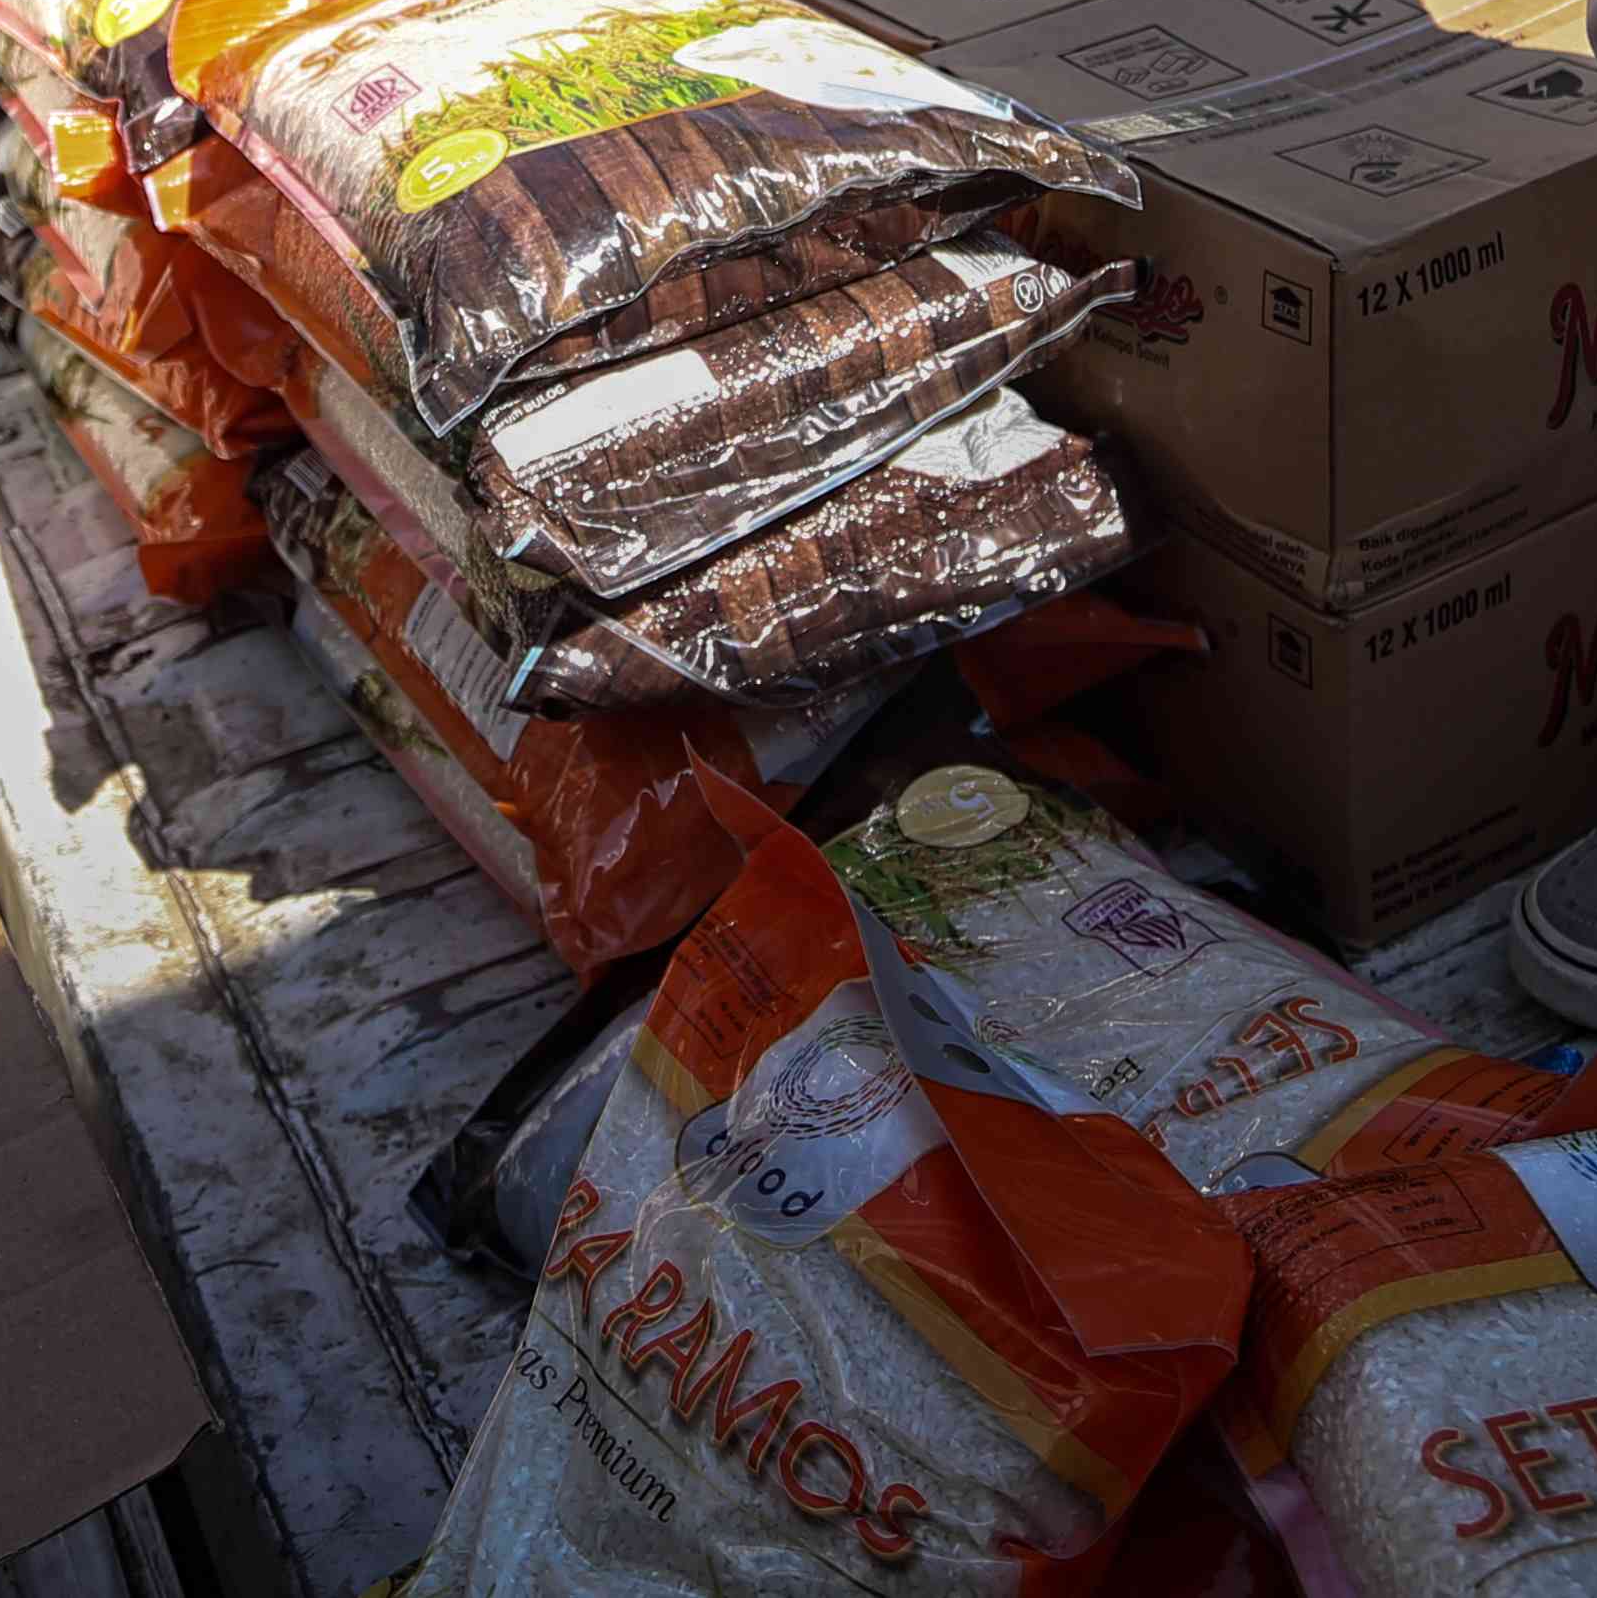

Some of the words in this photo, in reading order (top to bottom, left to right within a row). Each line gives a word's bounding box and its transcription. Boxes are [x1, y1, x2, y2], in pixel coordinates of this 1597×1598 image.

[418, 154, 456, 194] 5
[1357, 282, 1388, 317] 12
[1395, 270, 1413, 307] X
[1415, 246, 1472, 295] 1000
[1477, 230, 1506, 271] ml
[522, 382, 567, 415] BULOG
[1364, 628, 1394, 663] 12
[1402, 616, 1417, 649] X
[1425, 588, 1478, 637] 1000
[1484, 571, 1511, 610] ml
[552, 1375, 679, 1525] Premium
[602, 1259, 929, 1560] RAMOS
